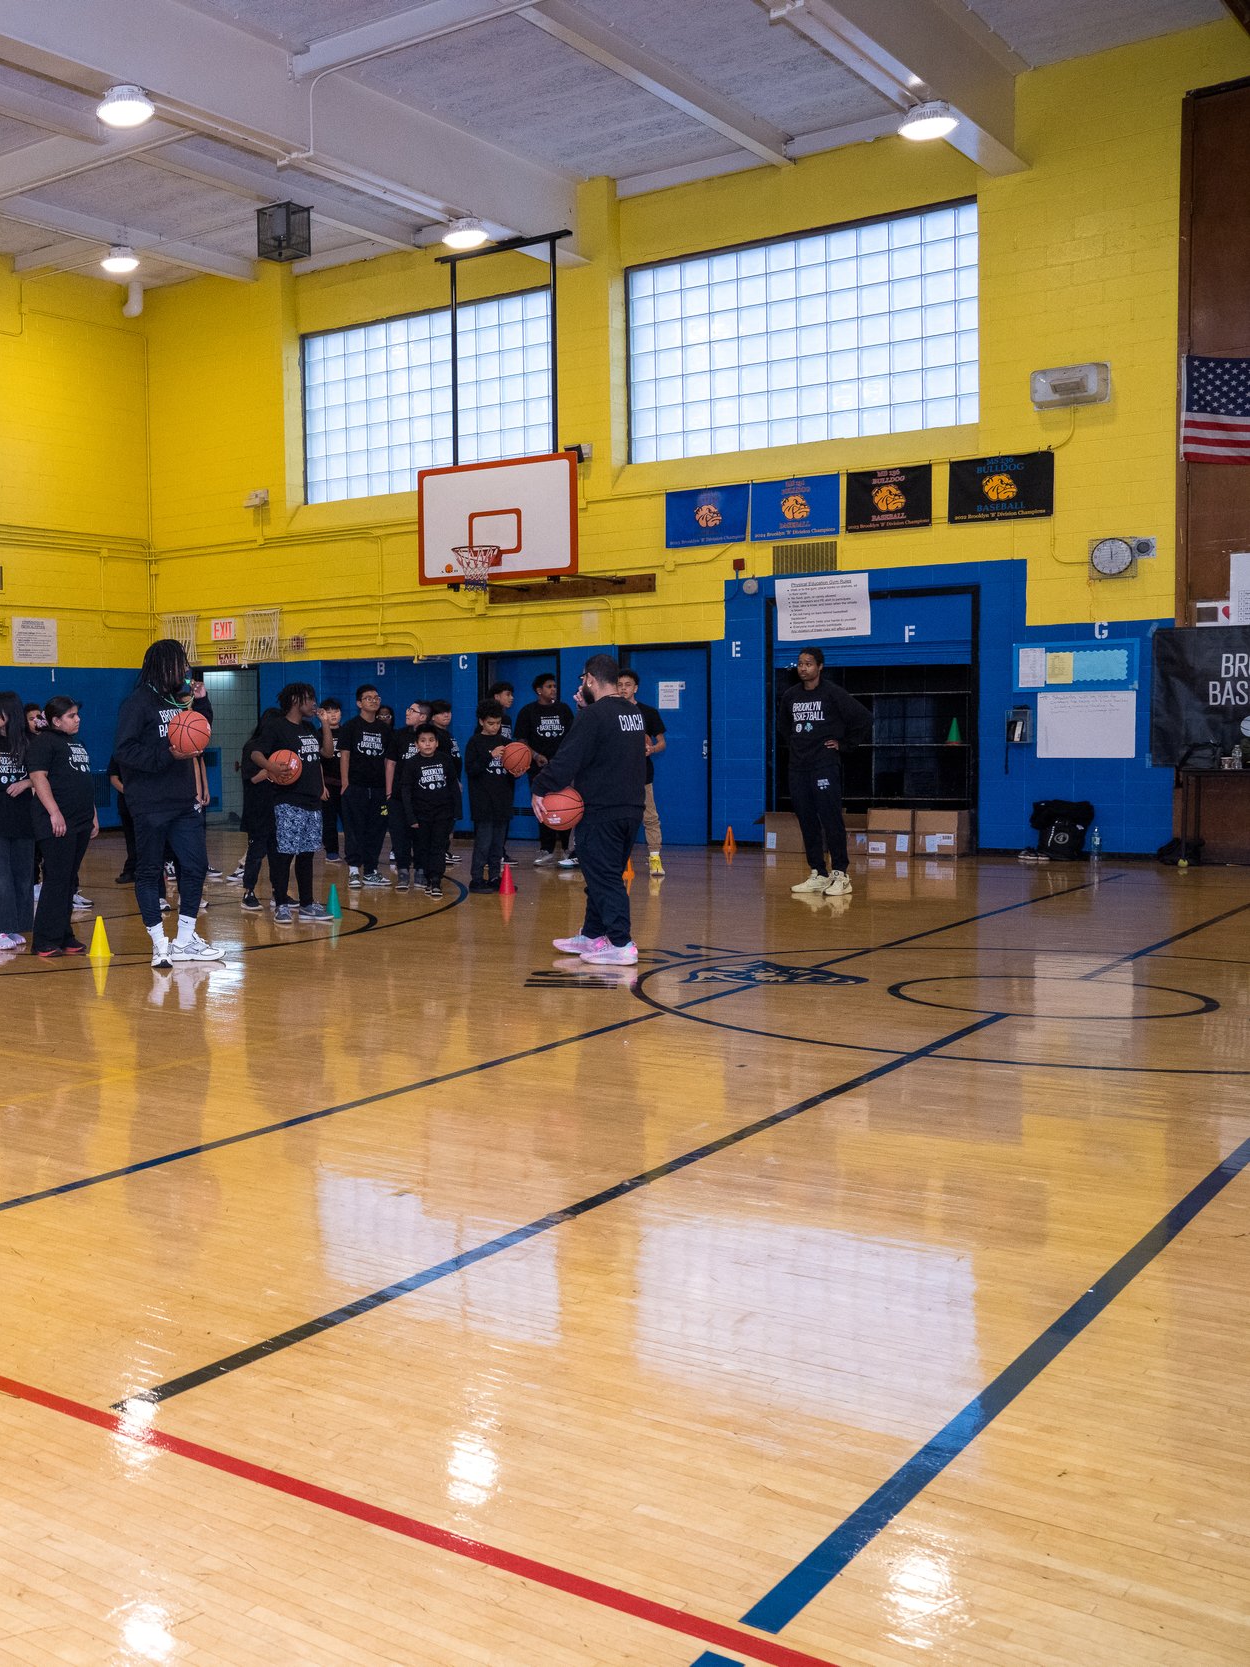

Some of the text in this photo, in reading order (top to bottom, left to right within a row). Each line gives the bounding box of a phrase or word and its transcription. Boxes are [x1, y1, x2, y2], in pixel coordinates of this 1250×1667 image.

[976, 462, 1024, 474] BULLDOG
[872, 476, 906, 484] BULLDOG
[976, 502, 1025, 512] BASEBALL
[871, 513, 906, 521] BASEBALL
[214, 622, 232, 639] EXIT
[905, 625, 915, 642] F
[1094, 622, 1108, 639] G
[732, 641, 741, 657] E
[459, 654, 468, 670] C
[1221, 653, 1250, 678] BR
[51, 669, 54, 682] 1
[377, 662, 385, 676] B
[792, 701, 822, 712] BROOKLYN
[618, 714, 644, 731] COACH
[792, 711, 825, 722] ASKETBALL
[361, 741, 382, 750] BASKETBALL
[422, 768, 443, 776] BROOKLYN
